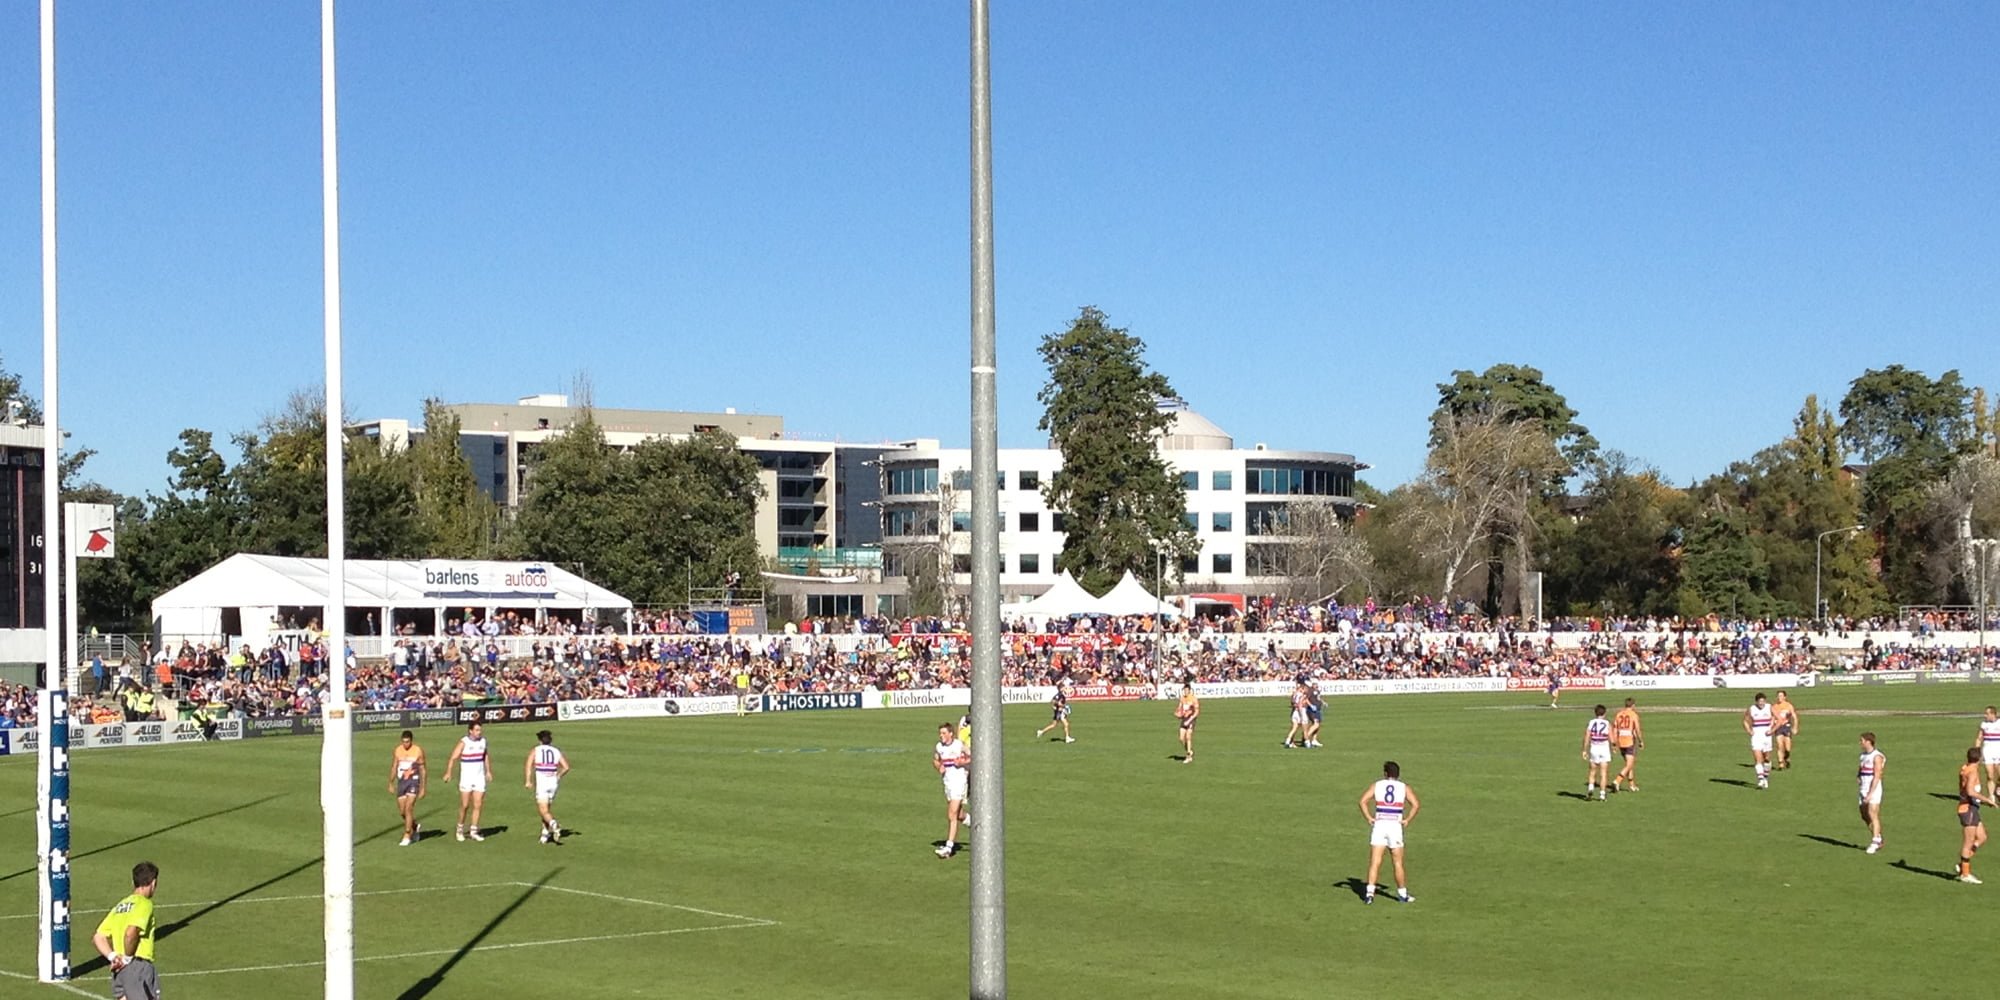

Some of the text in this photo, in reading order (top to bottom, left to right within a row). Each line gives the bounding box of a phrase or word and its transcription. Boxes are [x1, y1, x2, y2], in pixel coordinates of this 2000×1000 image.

[31, 535, 43, 548] 16
[30, 562, 42, 574] 31
[426, 567, 548, 587] barlens autoco
[1571, 678, 1605, 687] TOYOTA
[1076, 686, 1108, 696] TOYOTA
[789, 694, 857, 709] HOSTPLUS
[460, 710, 475, 721] ISC
[485, 709, 500, 720] ISC
[510, 708, 524, 719] ISC
[535, 706, 550, 717] ISC
[1619, 714, 1631, 729] 20
[101, 726, 123, 737] ALLIED
[140, 725, 162, 735] ALLIED
[1590, 721, 1607, 736] 42
[541, 748, 555, 765] 10
[1384, 784, 1395, 804] 8
